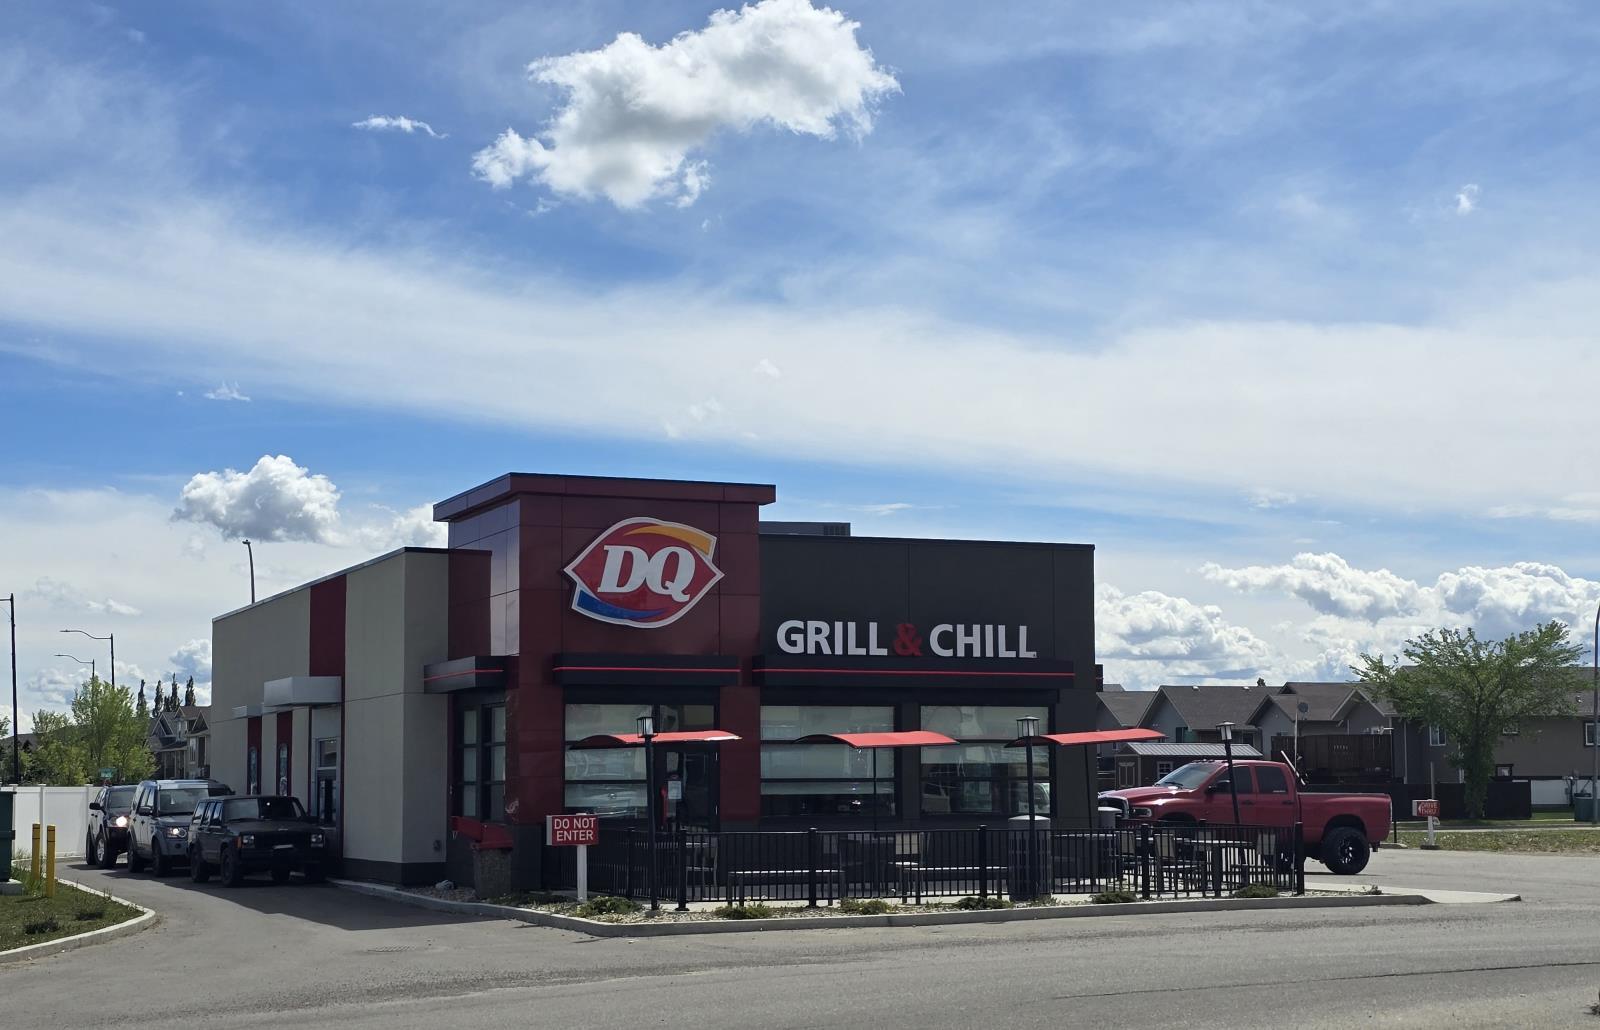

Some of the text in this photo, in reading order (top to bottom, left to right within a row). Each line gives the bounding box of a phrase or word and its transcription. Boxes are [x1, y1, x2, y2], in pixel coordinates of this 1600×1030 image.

[597, 545, 696, 602] DQ
[776, 620, 1037, 658] GRILL & CHILL
[554, 817, 596, 829] DO NOT
[556, 830, 594, 841] ENTER
